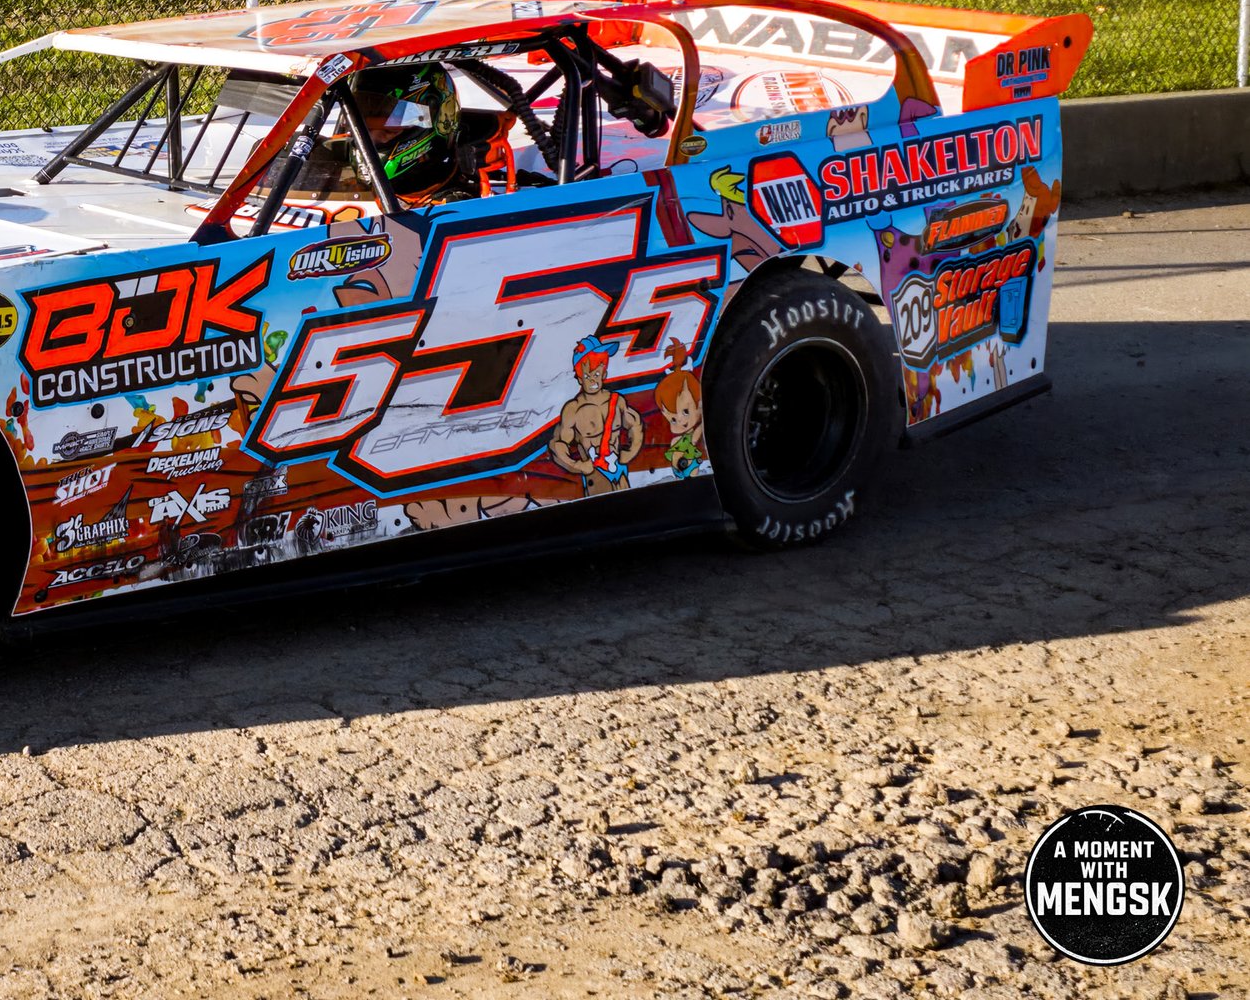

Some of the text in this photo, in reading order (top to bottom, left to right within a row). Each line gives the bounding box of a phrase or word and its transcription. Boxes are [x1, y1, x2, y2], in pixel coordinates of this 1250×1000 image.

[997, 46, 1050, 78] DR PINK
[821, 119, 1040, 201] SHAKELTON
[760, 176, 817, 227] NAPA
[828, 167, 1013, 220] AUTO & TRUCK PARTS
[293, 244, 386, 271] DIRTVision
[934, 249, 1031, 308] Storage
[900, 288, 997, 349] 209 Vault
[37, 337, 258, 401] CONSTRUCTION
[150, 412, 231, 442] SIGNS
[148, 447, 221, 473] DECKELMAN
[162, 460, 224, 481] Trucking
[52, 462, 118, 505] SHOT
[325, 501, 378, 529] KING
